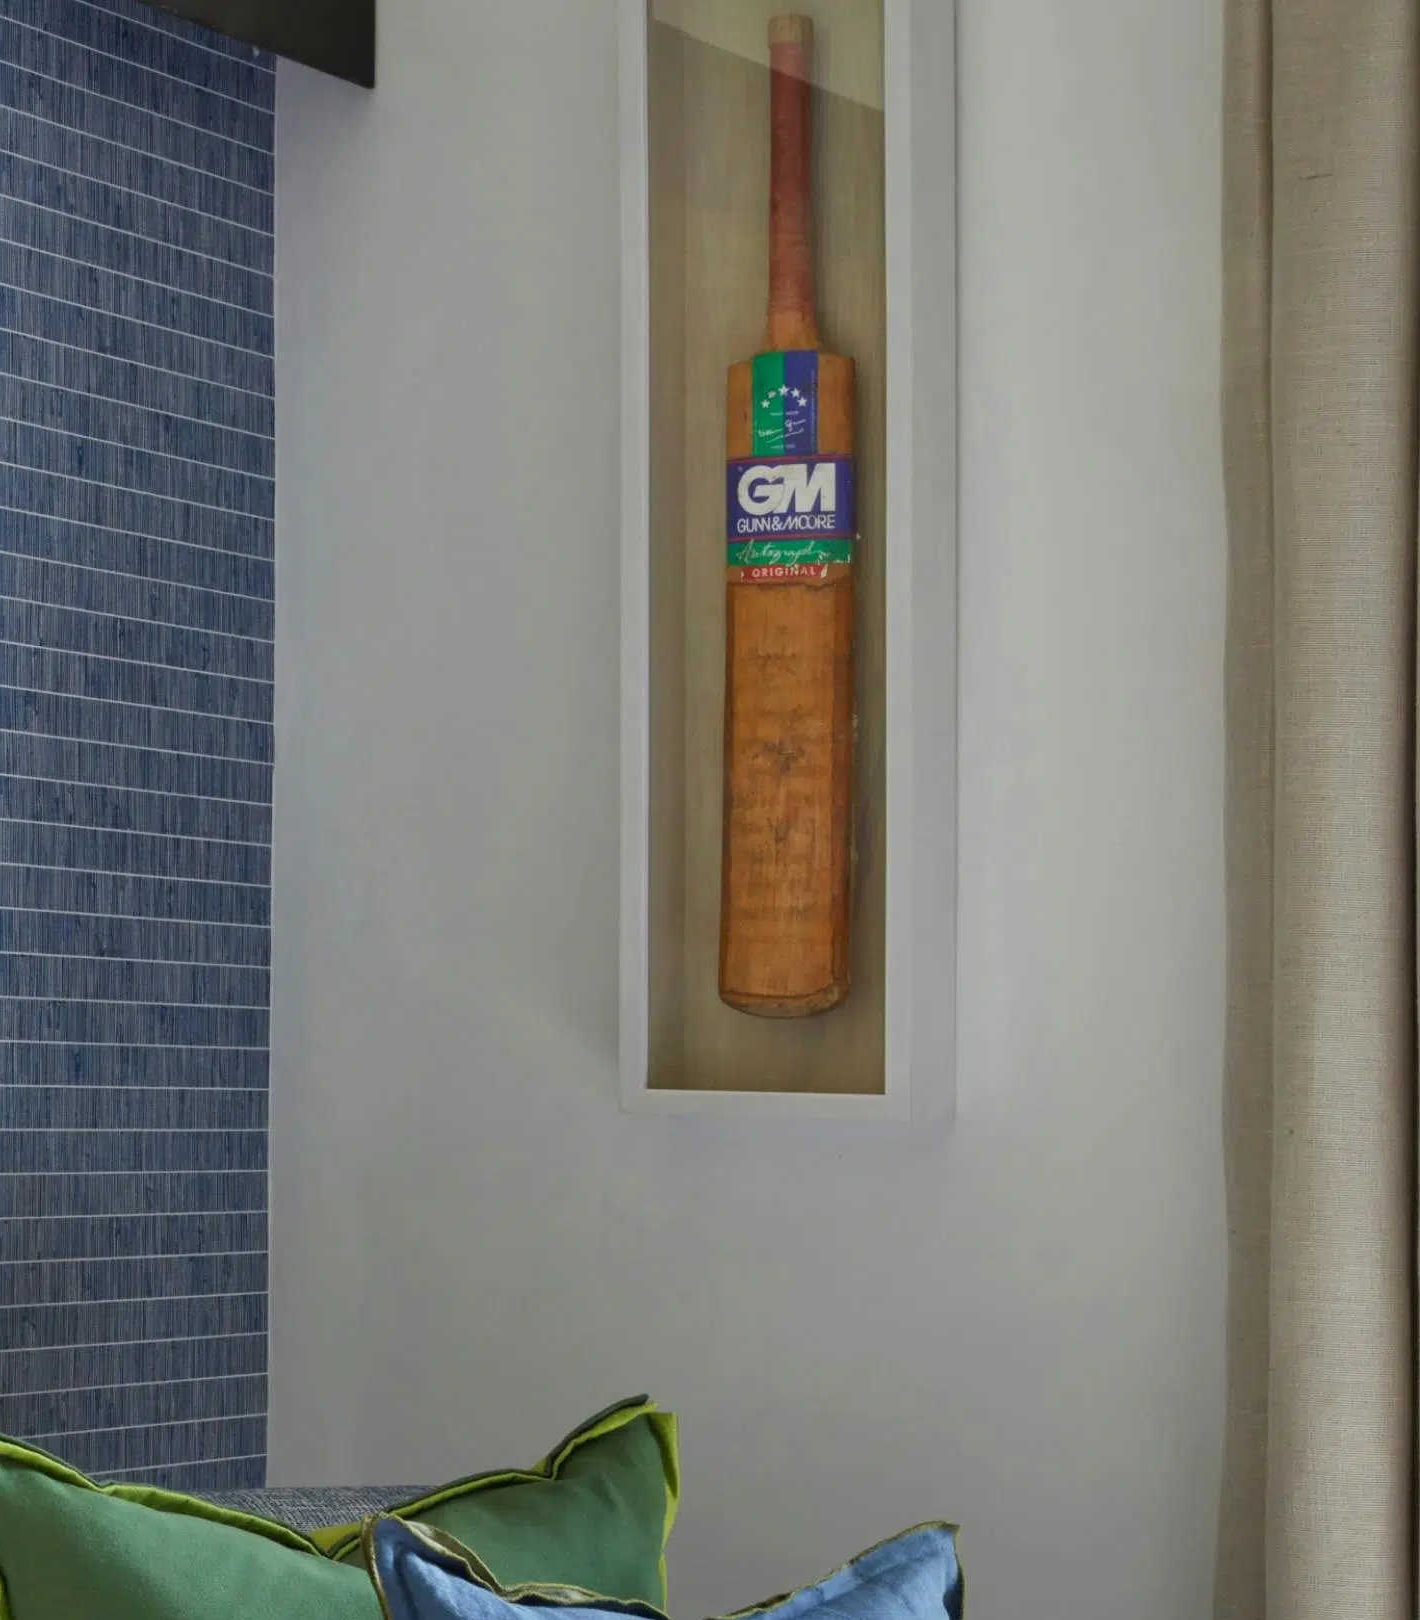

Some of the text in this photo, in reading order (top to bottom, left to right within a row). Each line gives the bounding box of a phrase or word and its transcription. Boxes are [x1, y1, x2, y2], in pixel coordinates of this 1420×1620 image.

[737, 462, 836, 516] GM
[736, 514, 836, 533] GUNN&MOORE
[751, 566, 817, 578] ORIGINAL
